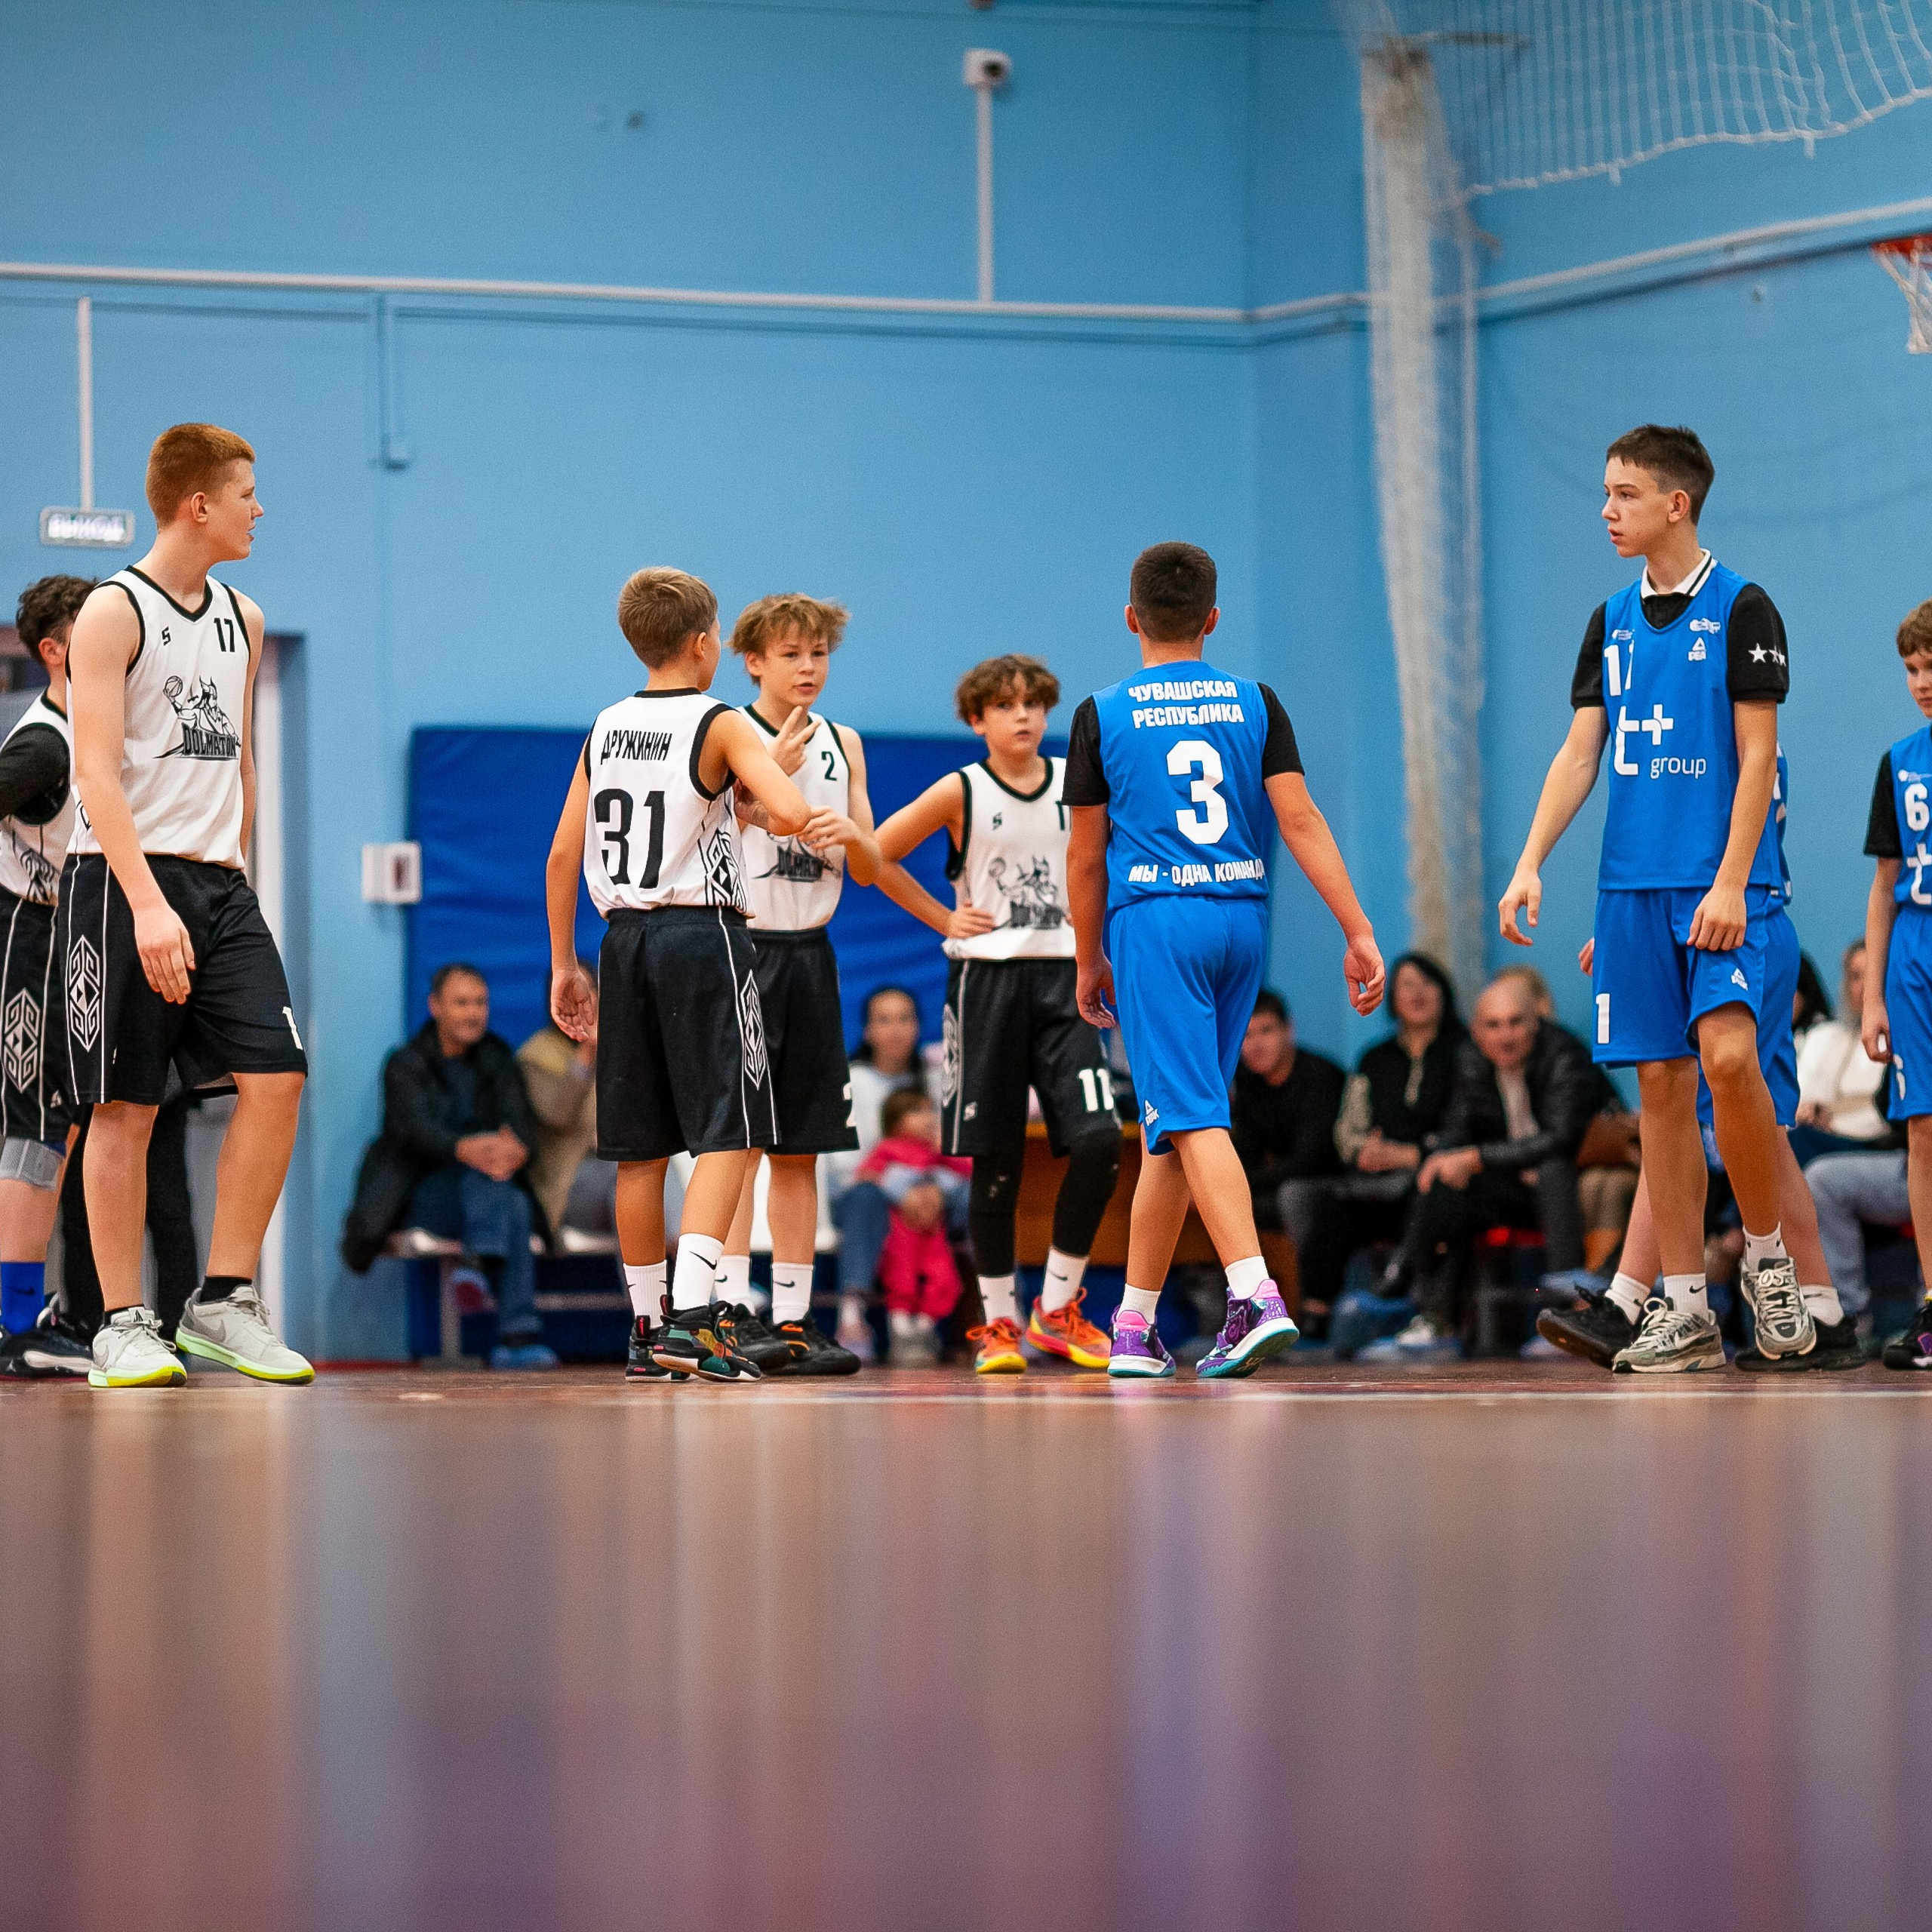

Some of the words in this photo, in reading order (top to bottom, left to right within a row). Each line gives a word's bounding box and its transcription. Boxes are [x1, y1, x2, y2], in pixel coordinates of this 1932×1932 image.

[214, 617, 235, 652] 17
[1128, 680, 1238, 703] ЧУВАШСКАЯ
[1132, 703, 1244, 729] РЕСПУБЛИКА
[181, 723, 236, 756] DOLMATON
[600, 730, 672, 765] ДРУЖИНИН
[821, 751, 837, 782] 2
[1650, 757, 1706, 780] group
[1166, 740, 1229, 844] 3
[1904, 783, 1930, 831] 6
[594, 788, 666, 889] 31
[1128, 864, 1158, 883] МЫ
[1171, 864, 1213, 888] ОДНА
[1595, 993, 1611, 1044] 1
[1078, 1068, 1115, 1112] 11
